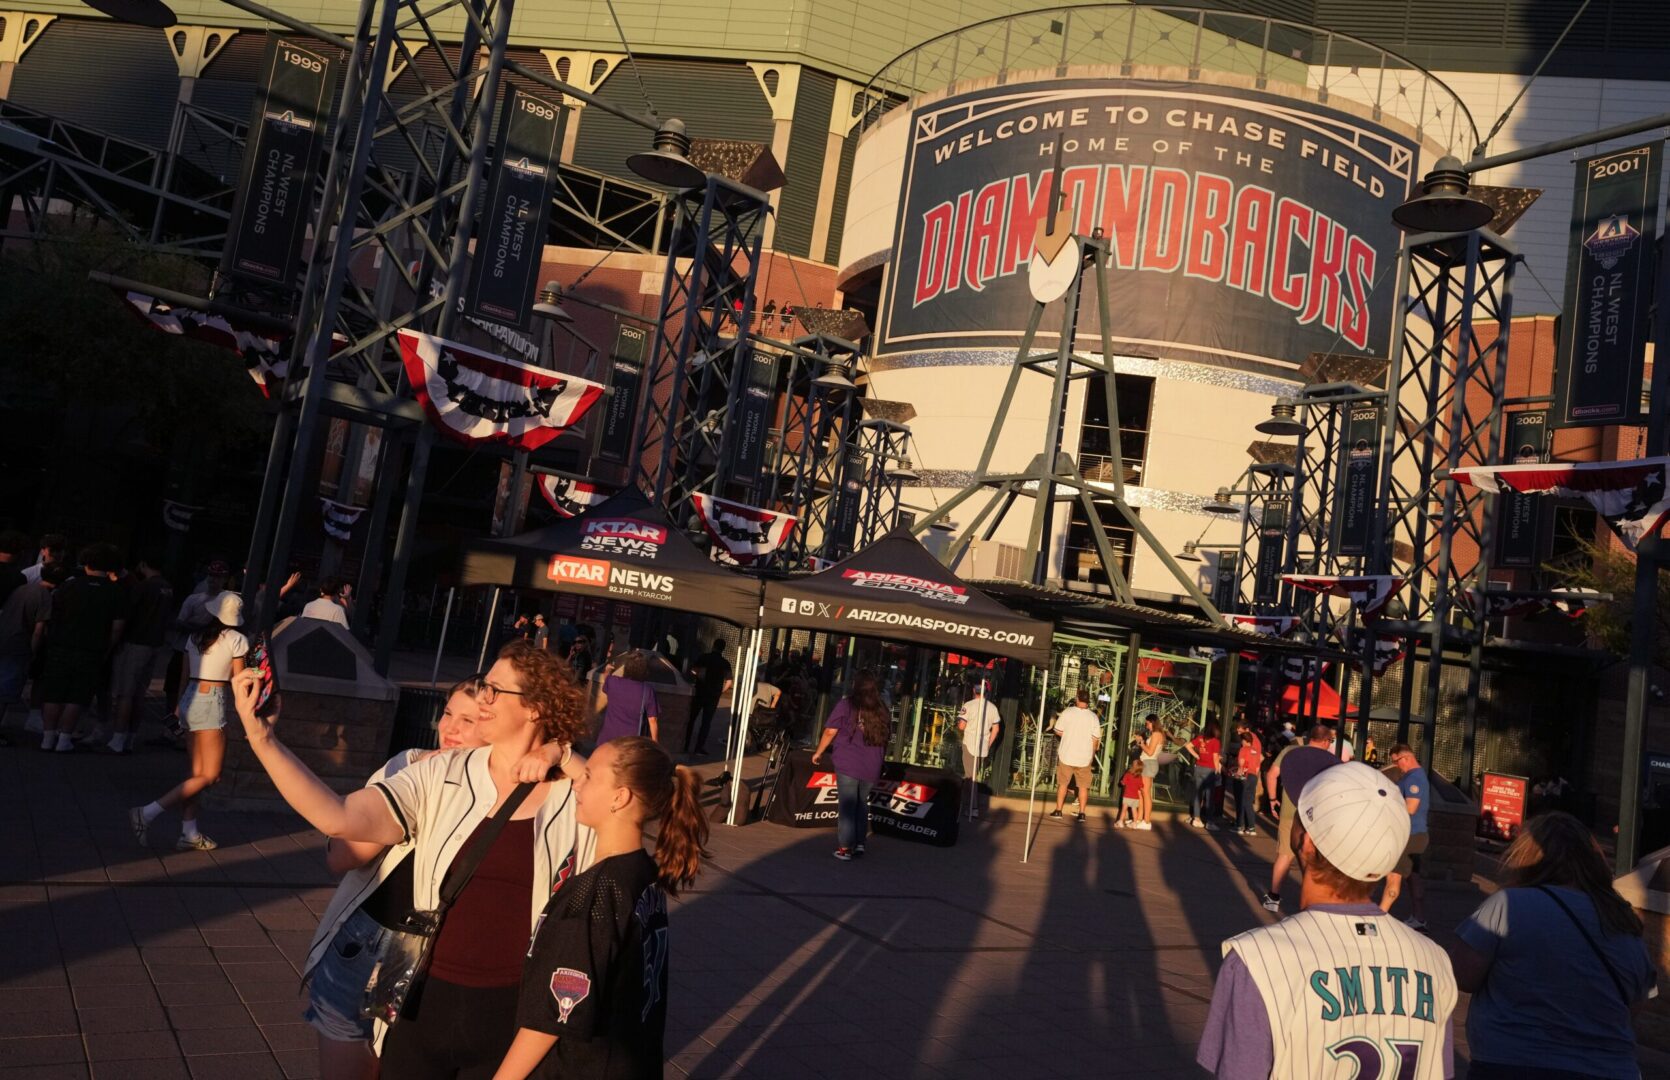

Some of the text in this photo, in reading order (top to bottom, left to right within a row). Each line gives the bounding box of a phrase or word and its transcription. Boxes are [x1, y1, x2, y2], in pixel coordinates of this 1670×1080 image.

[284, 50, 322, 73] 1999
[520, 99, 554, 121] 1999
[281, 153, 296, 173] NL
[934, 106, 1385, 199] WELCOME TO CHASE FIELD
[1038, 137, 1275, 174] HOME OF THE
[1593, 157, 1640, 179] 2001
[254, 148, 280, 235] CHAMPIONS
[273, 176, 292, 217] WEST
[517, 199, 531, 218] NL
[493, 194, 518, 279] CHAMPIONS
[510, 221, 529, 262] WEST
[912, 163, 1378, 351] DIAMONDBACKS
[1584, 275, 1605, 374] CHAMPIONS
[1604, 272, 1623, 346] NL WEST
[621, 329, 642, 341] 2001
[753, 353, 772, 365] 2001
[607, 385, 621, 436] CHAMPIONS
[619, 388, 631, 419] WORLD
[1352, 412, 1376, 421] 2002
[740, 410, 754, 460] CHAMPIONS
[750, 412, 761, 443] WORLD
[1516, 416, 1543, 425] 2002
[1347, 473, 1359, 529] CHAMPIONS
[582, 535, 659, 552] NEWS
[587, 521, 661, 541] KTAR
[580, 543, 656, 559] 92.3 FM
[552, 560, 674, 592] KTAR NEWS
[849, 571, 955, 595] ARIZONA
[609, 585, 623, 594] 92.3
[638, 590, 672, 602] KTAR.COM
[846, 608, 1036, 647] ARIZONASPORTS.COM
[794, 812, 813, 821] THE
[897, 820, 938, 838] LEADER
[1310, 965, 1436, 1024] SMITH
